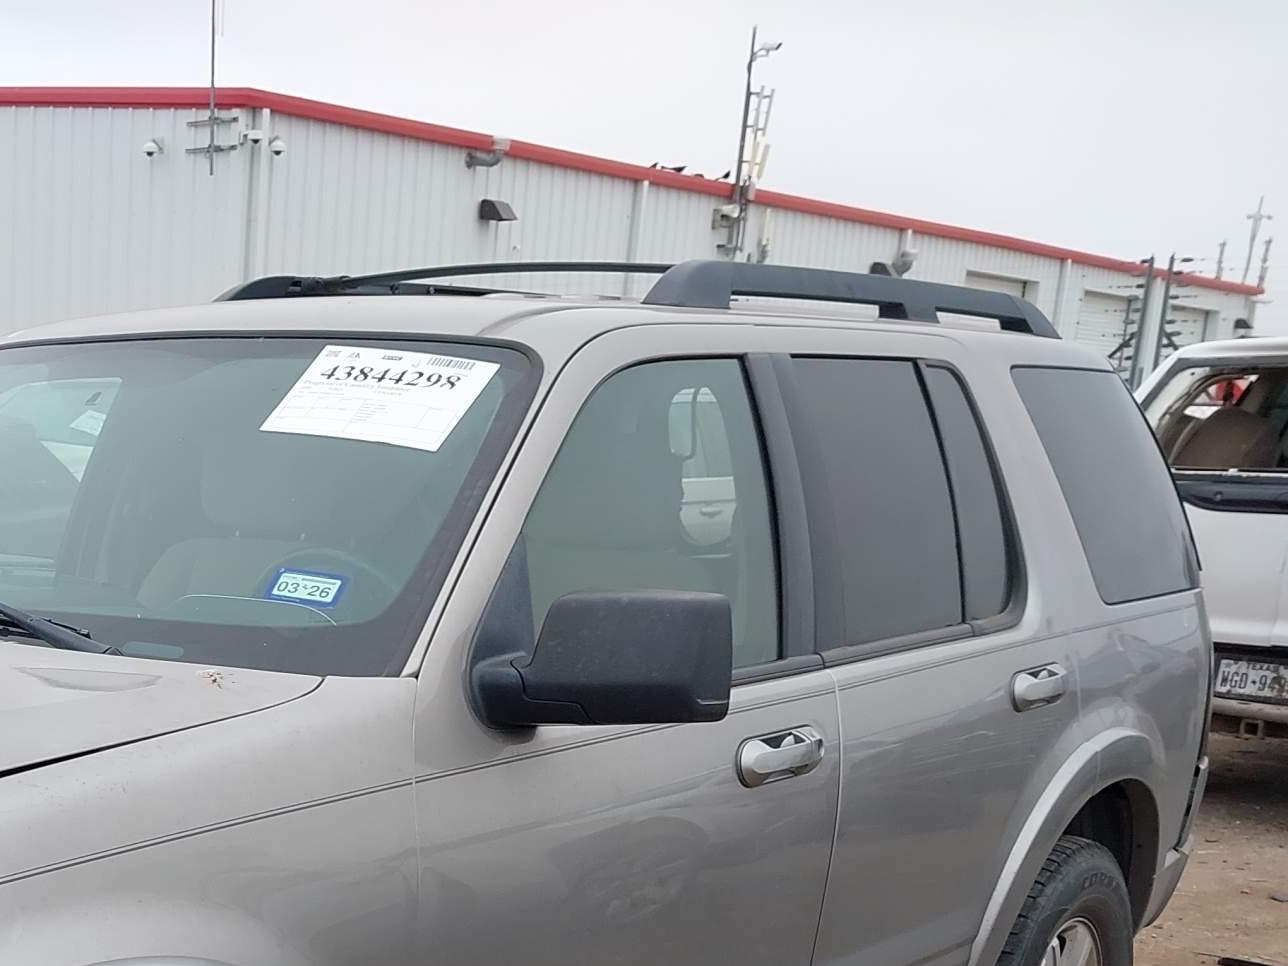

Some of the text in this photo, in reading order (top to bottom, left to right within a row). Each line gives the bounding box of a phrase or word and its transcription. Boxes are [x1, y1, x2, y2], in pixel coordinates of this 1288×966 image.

[320, 364, 462, 391] 43844298
[276, 581, 332, 598] 03 26
